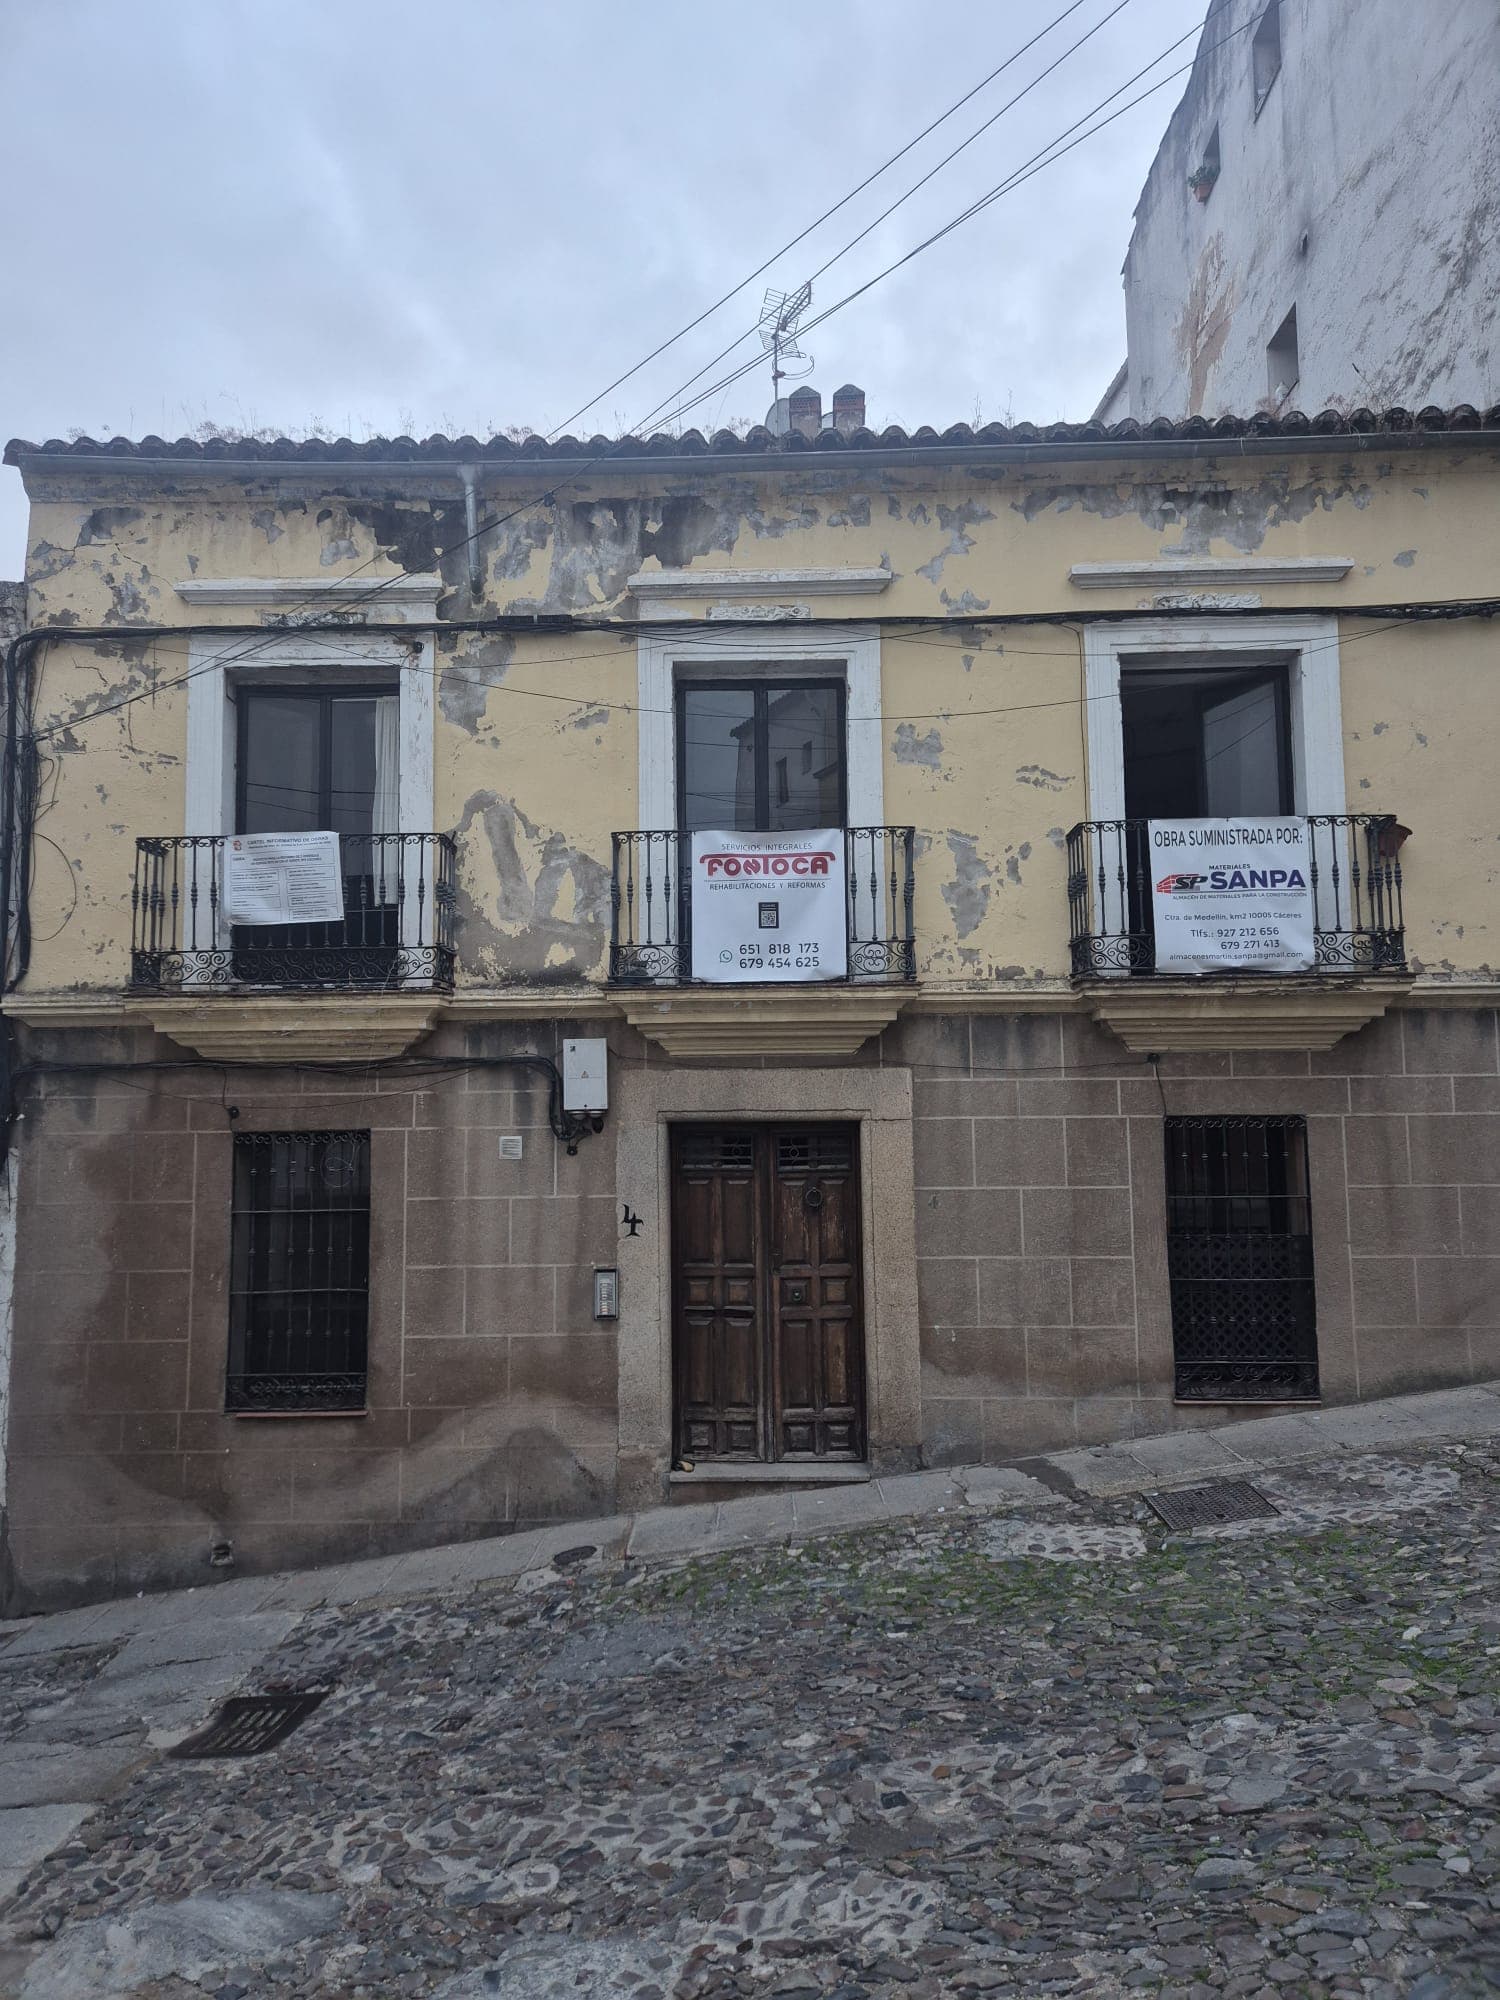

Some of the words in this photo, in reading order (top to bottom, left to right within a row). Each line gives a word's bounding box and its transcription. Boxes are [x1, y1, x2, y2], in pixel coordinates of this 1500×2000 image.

[1154, 831, 1186, 848] OBRA
[1189, 828, 1274, 846] SUMINISTRADA
[1276, 828, 1303, 844] POR:
[700, 852, 836, 876] FONTOCA
[710, 882, 776, 890] REHABILITACIONES
[1174, 876, 1208, 890] SP
[1210, 870, 1306, 890] SANPA
[1216, 929, 1236, 938] 927
[1239, 928, 1256, 936] 212
[1260, 927, 1280, 936] 656
[740, 944, 760, 954] 651
[768, 944, 790, 954] 818
[798, 942, 820, 953] 173
[1220, 941, 1240, 950] 679
[1244, 940, 1260, 949] 271
[1264, 940, 1280, 948] 413
[740, 958, 764, 968] 679
[768, 958, 792, 968] 454
[795, 957, 820, 968] 625
[620, 1203, 644, 1238] 4
